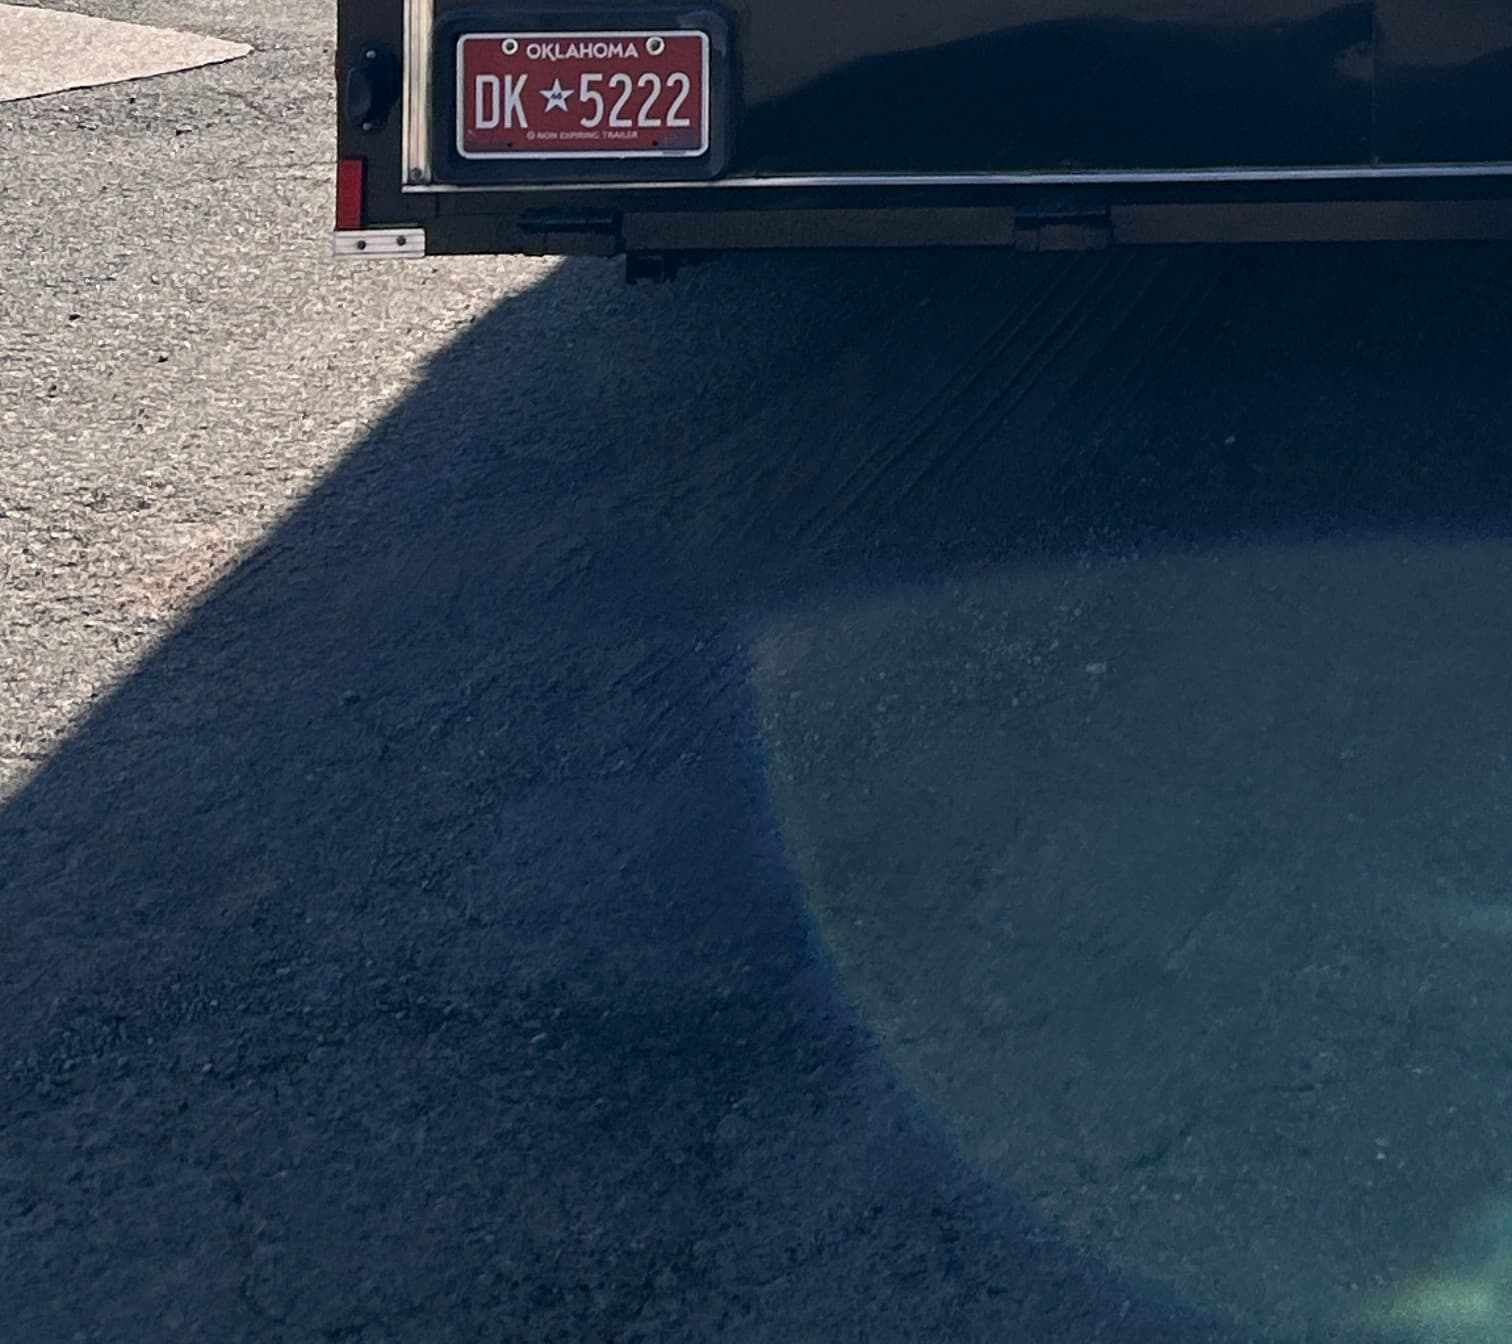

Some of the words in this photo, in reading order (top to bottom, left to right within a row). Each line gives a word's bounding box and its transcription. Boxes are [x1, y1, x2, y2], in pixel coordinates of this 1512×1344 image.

[526, 42, 639, 61] OKLAHOMA
[475, 74, 528, 129] DK
[579, 72, 690, 128] 5222
[602, 130, 639, 140] TRAILER
